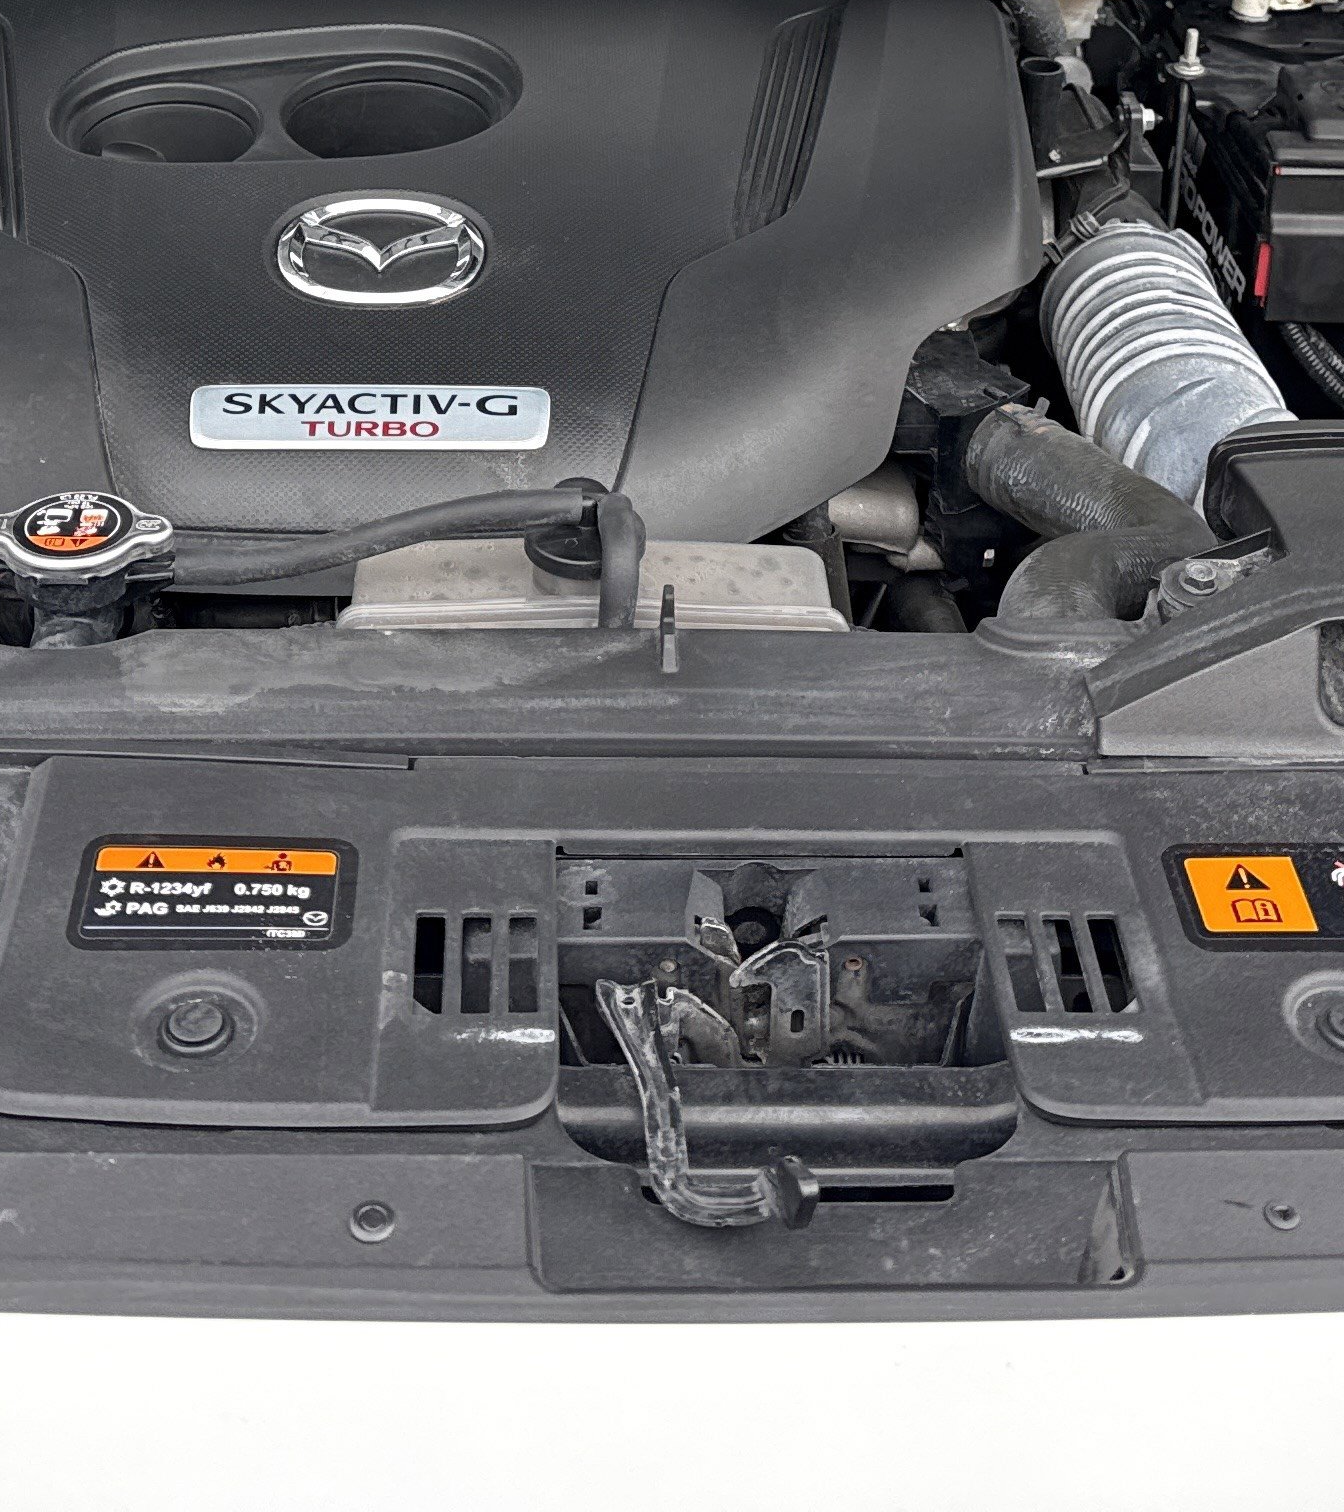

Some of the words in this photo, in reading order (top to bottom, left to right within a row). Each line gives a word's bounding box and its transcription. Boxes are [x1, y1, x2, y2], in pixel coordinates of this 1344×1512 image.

[222, 392, 518, 416] SKYACTIV-G
[300, 420, 440, 438] TURBO
[129, 881, 213, 898] R-1234yf
[233, 883, 284, 896] 0.750
[286, 884, 311, 899] kg
[125, 901, 169, 915] PAG
[175, 904, 201, 913] SAE
